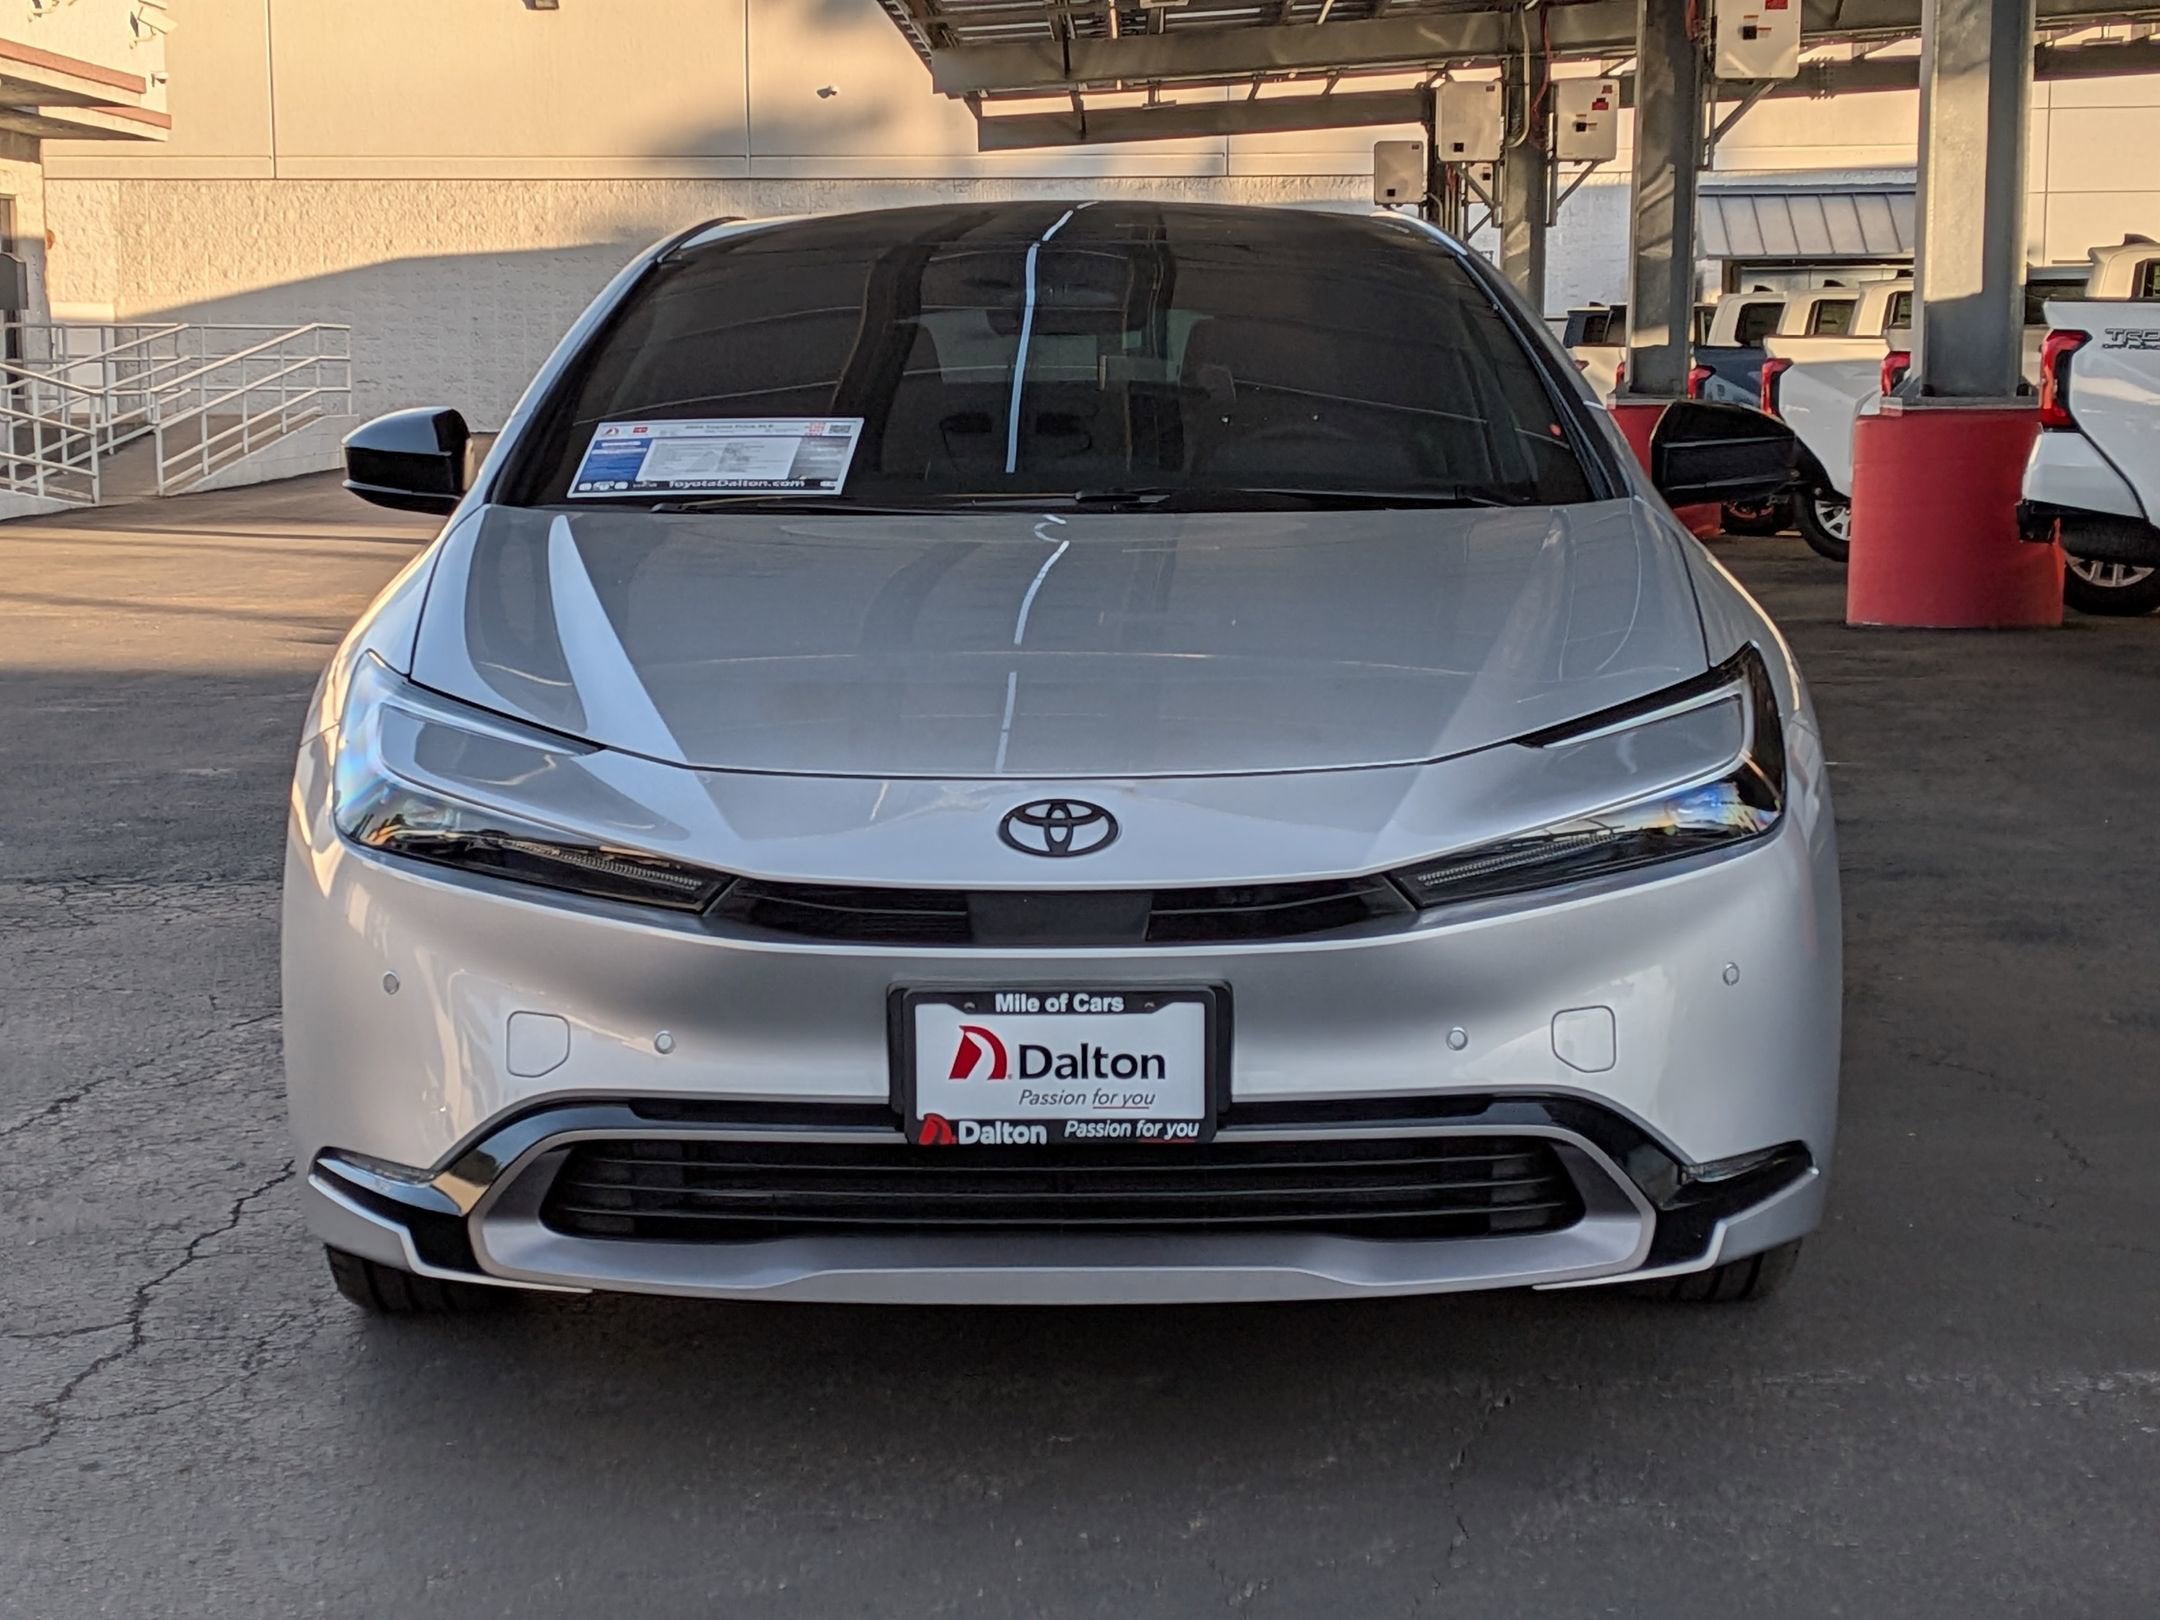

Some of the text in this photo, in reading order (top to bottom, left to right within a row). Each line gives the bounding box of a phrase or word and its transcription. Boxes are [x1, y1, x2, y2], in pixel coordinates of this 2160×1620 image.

[995, 993, 1124, 1013] Mile of Cars
[1019, 1043, 1166, 1080] Dalton
[1019, 1088, 1156, 1109] Passion for you
[958, 1119, 1200, 1145] Dalton Passion for you
